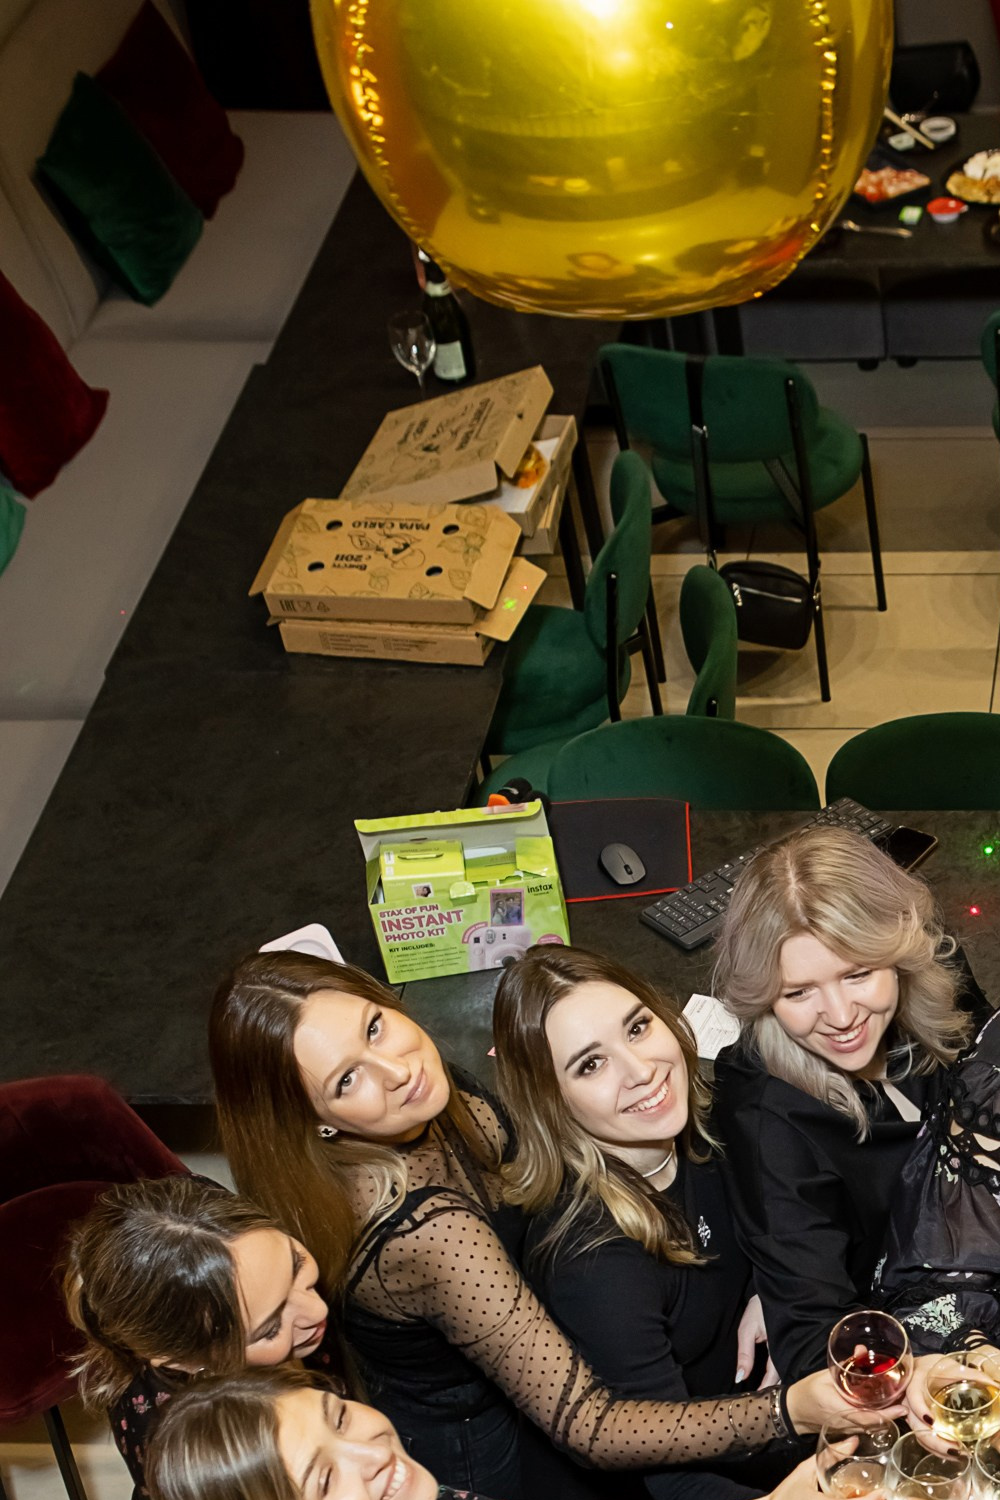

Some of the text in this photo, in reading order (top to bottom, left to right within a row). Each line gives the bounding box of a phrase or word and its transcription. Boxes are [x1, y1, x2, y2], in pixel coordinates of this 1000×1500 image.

[352, 520, 430, 531] PAPA CARLO
[527, 883, 553, 894] instax
[379, 904, 439, 918] STAX OF FUN
[381, 909, 463, 932] INSTANT
[385, 928, 445, 942] PHOTO KIT
